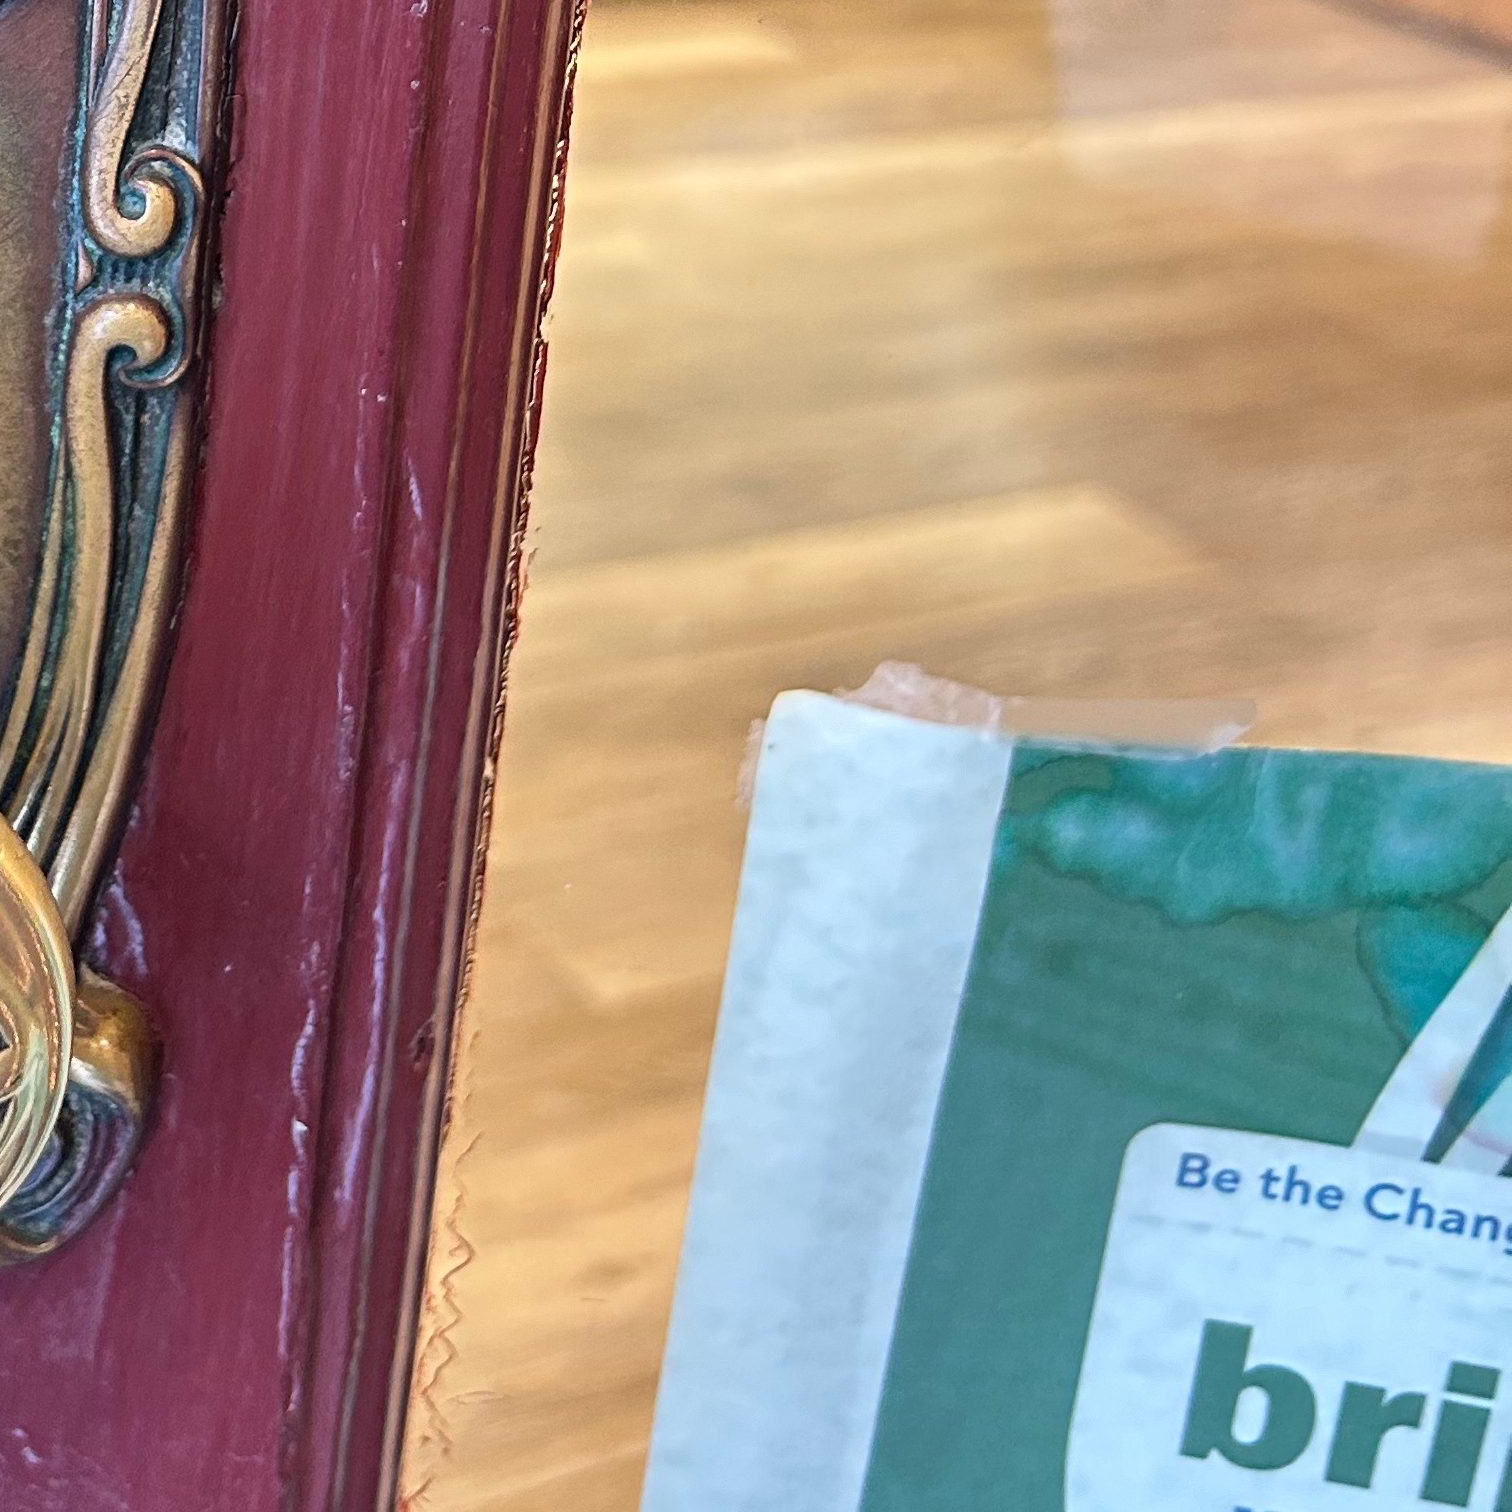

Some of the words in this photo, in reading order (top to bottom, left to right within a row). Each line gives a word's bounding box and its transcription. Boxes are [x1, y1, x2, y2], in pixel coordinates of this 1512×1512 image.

[1176, 1152, 1241, 1194] Be
[1260, 1165, 1345, 1210] the
[1179, 1318, 1512, 1512] bri
